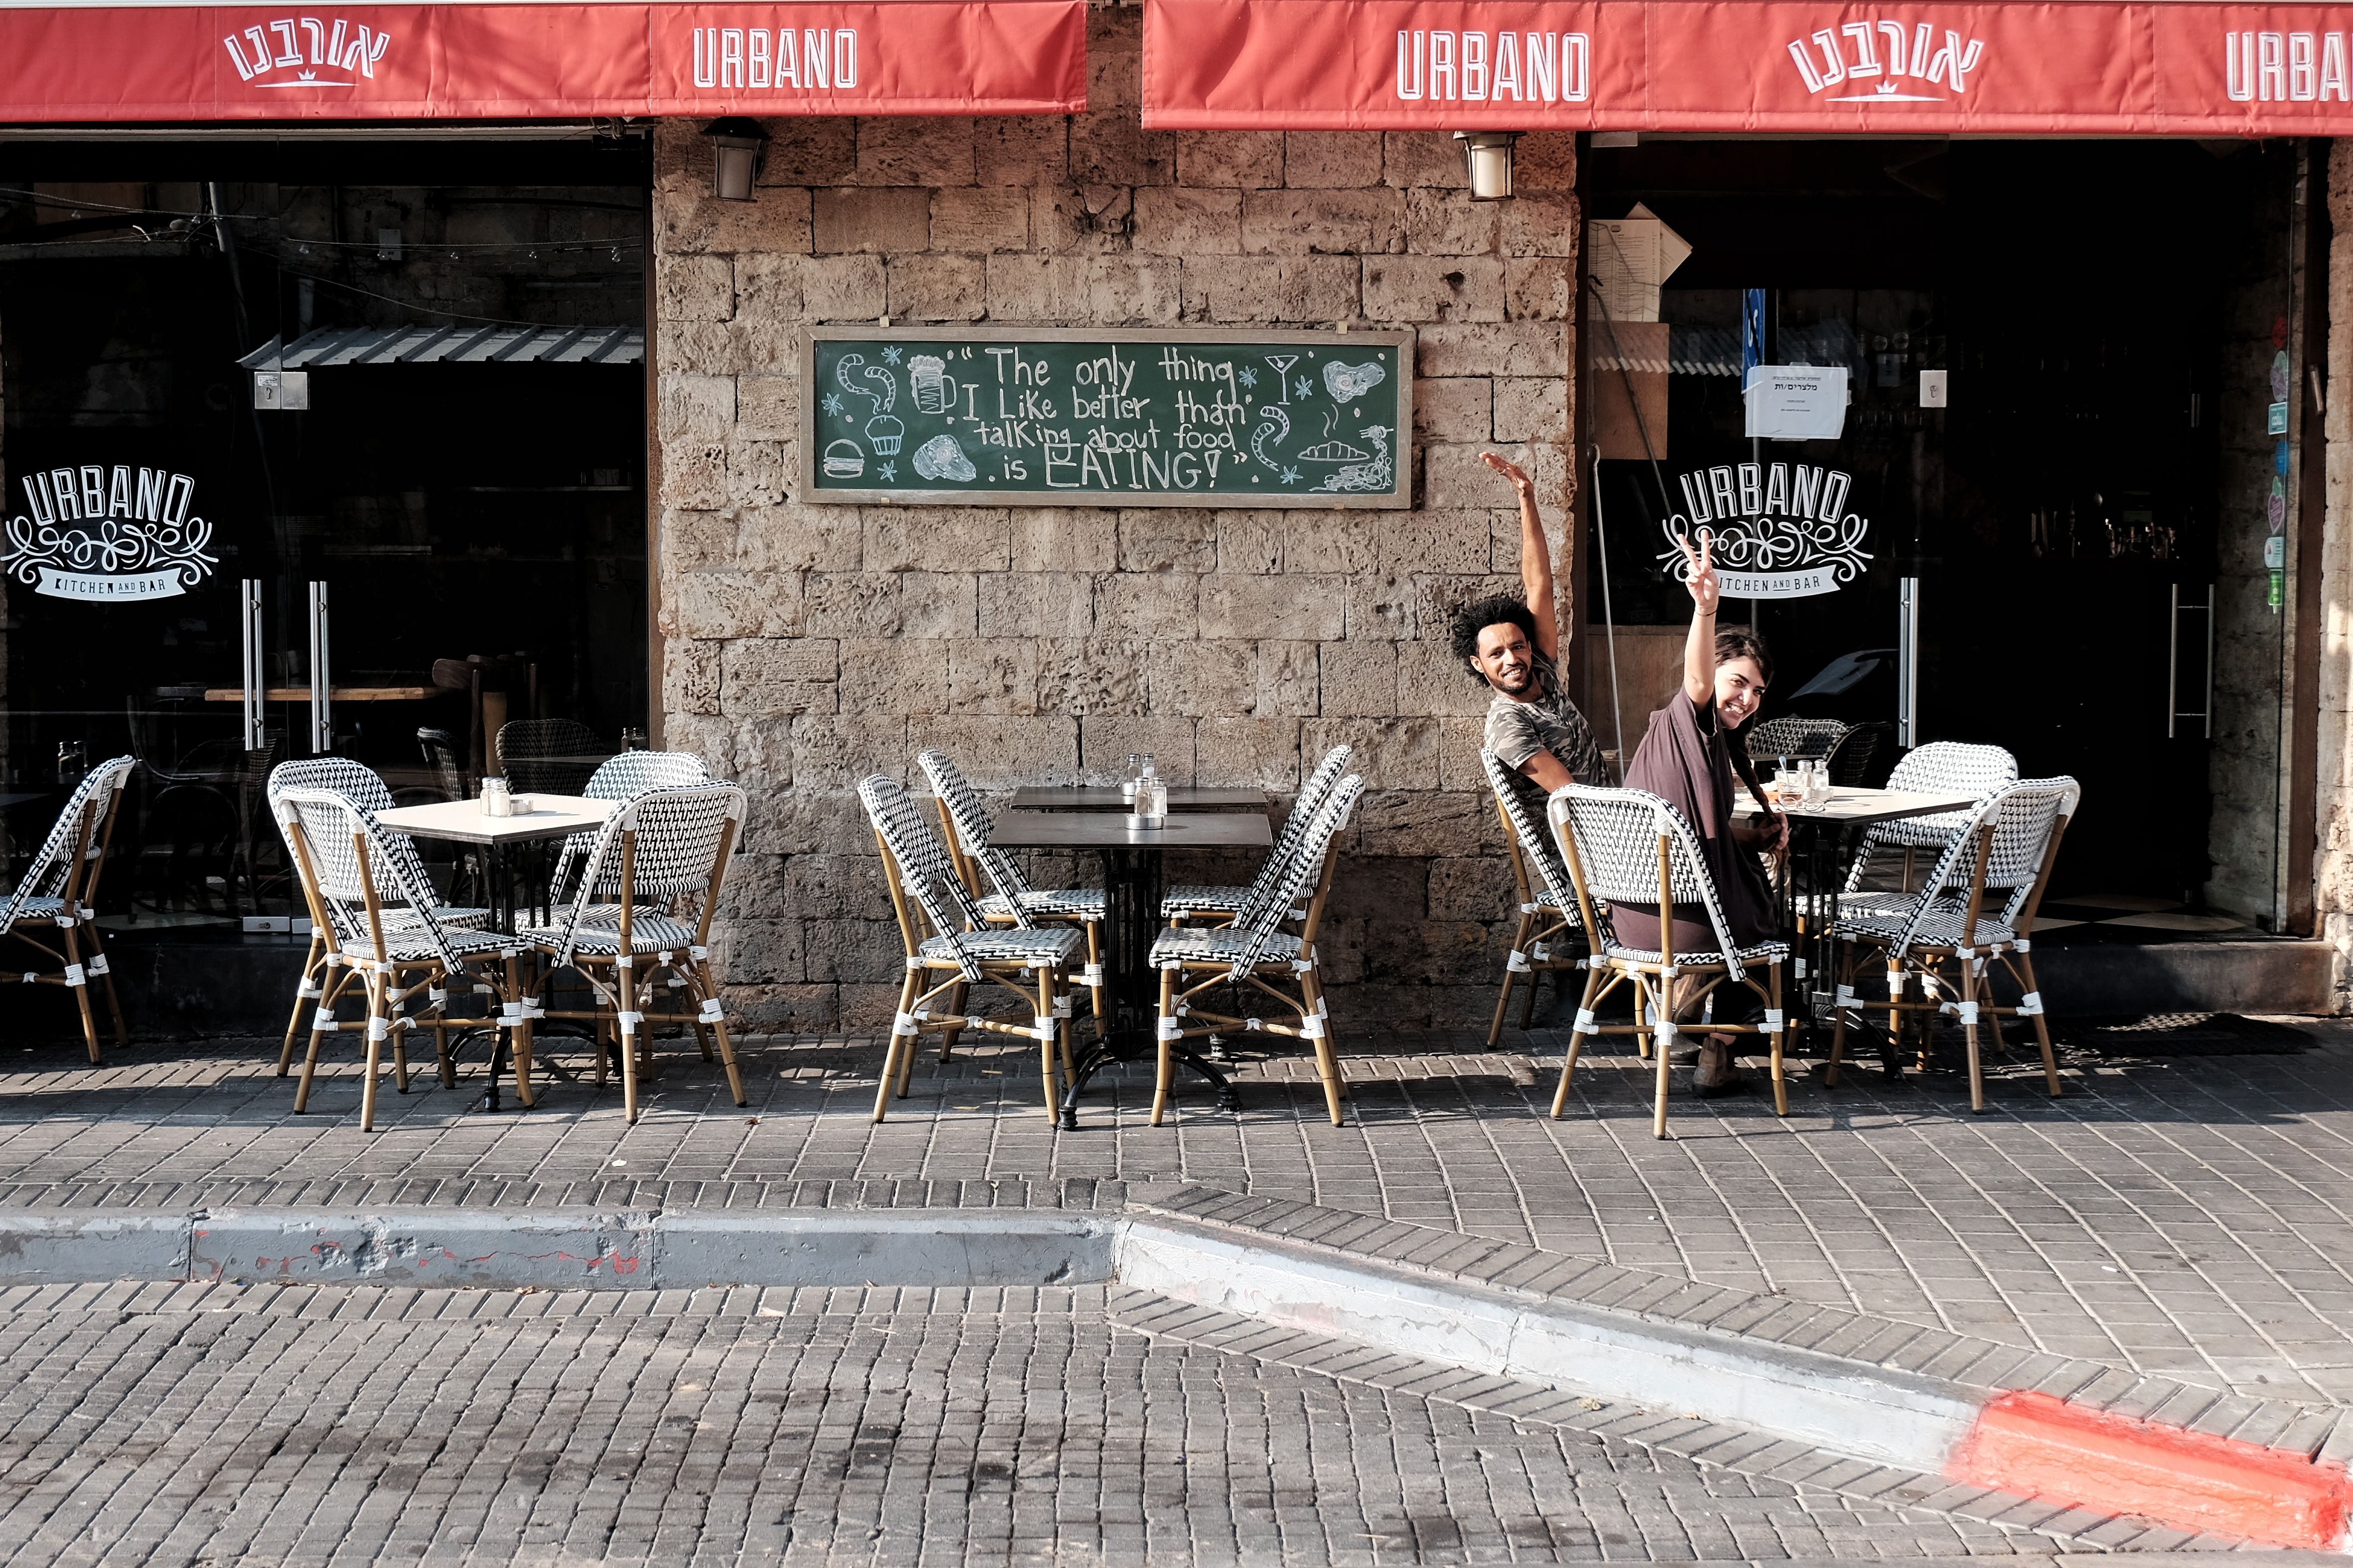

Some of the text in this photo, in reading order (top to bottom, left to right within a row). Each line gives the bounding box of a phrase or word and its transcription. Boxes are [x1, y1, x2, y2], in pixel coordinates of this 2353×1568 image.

[224, 18, 390, 81] אורבנו
[694, 28, 857, 88] URBANO
[1397, 30, 1589, 102] URBANO
[1787, 20, 1984, 94] אורבנו
[2226, 32, 2353, 102] URBA
[962, 384, 979, 421] I
[1072, 384, 1150, 419] better
[1175, 390, 1246, 425] than
[1076, 345, 1135, 396] only
[1158, 347, 1237, 409] thing
[1774, 383, 1817, 391] מלצרים/ות
[1088, 418, 1160, 448] about
[1173, 420, 1236, 451] food
[23, 465, 195, 527] URBANO
[1004, 454, 1027, 481] is
[1680, 463, 1851, 524] URBANO
[55, 578, 166, 594] KITCHEN AND BAR
[1719, 576, 1820, 591] ITCHEN AND BAR
